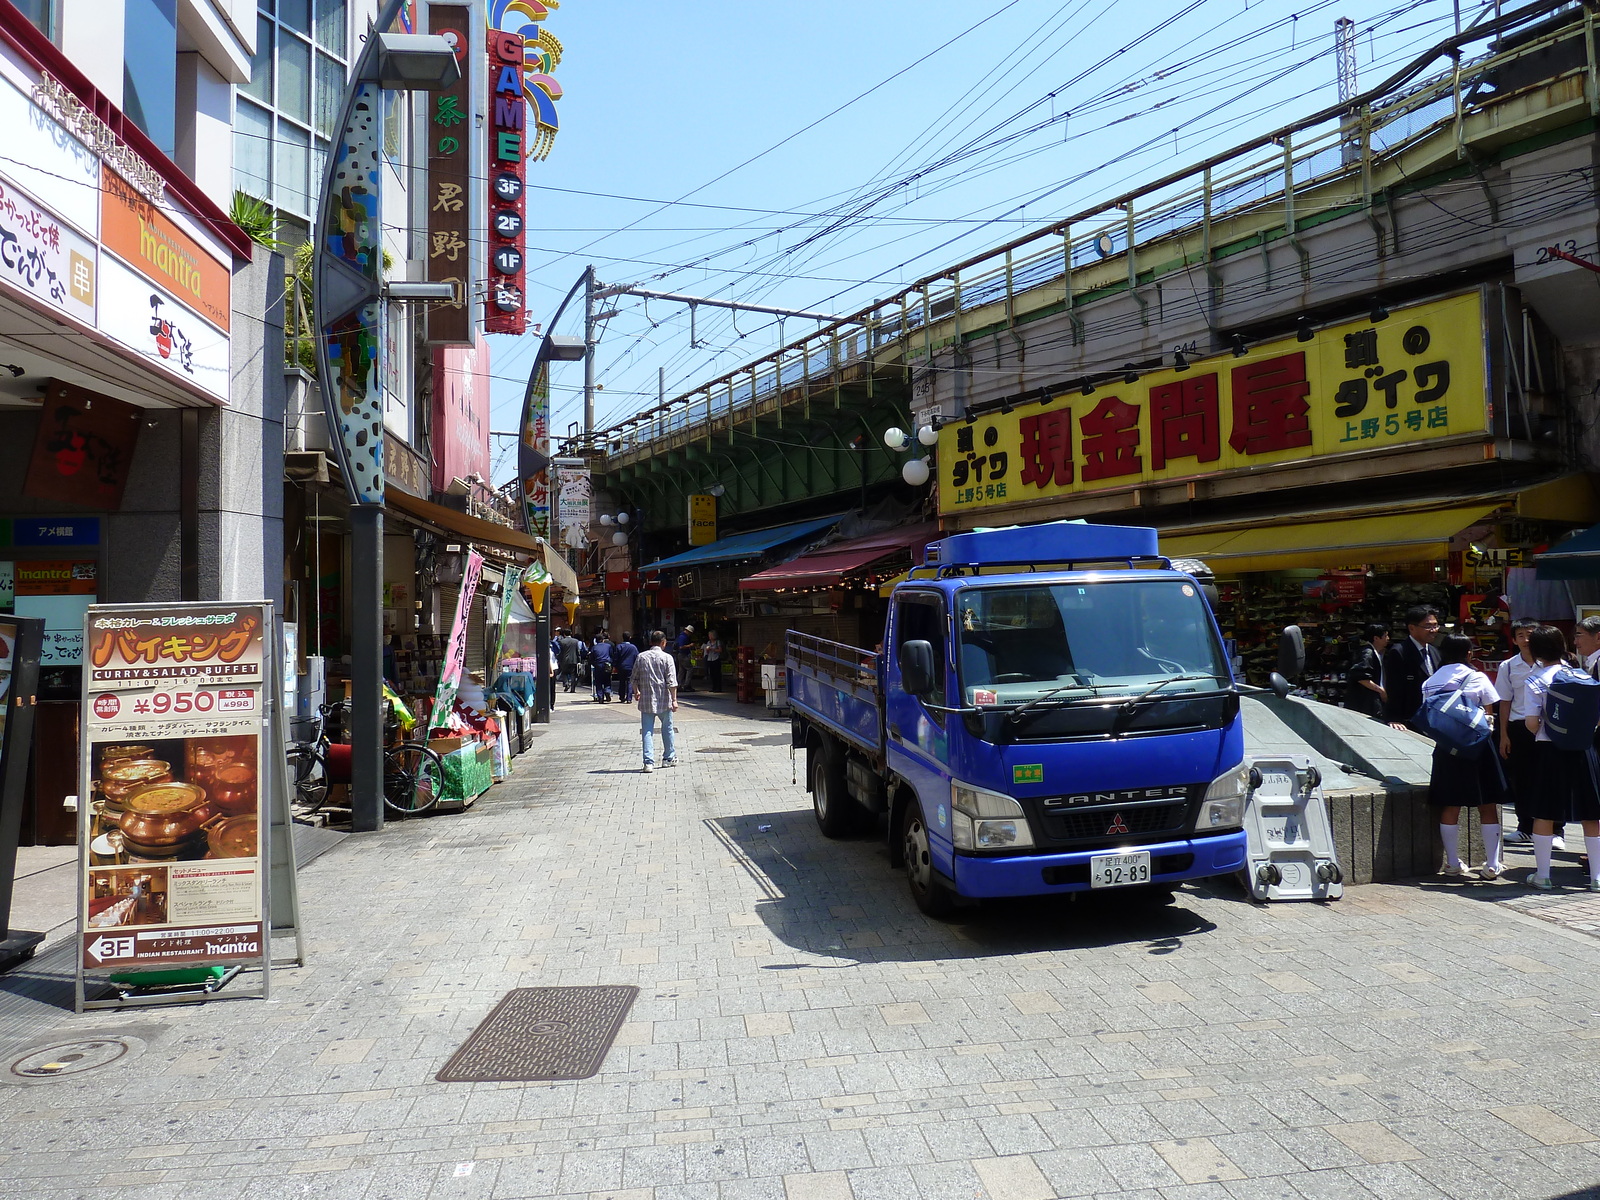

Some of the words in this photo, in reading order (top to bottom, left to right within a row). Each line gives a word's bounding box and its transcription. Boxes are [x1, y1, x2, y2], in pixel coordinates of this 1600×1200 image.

[496, 33, 523, 162] GAME
[498, 178, 520, 194] 3F
[498, 216, 520, 230] 2F
[138, 214, 201, 298] mantra
[498, 253, 519, 268] 1F
[74, 260, 90, 297] 串
[1335, 360, 1449, 418] ダイワ
[1019, 351, 1312, 489] 現金問屋
[1340, 406, 1448, 443] 上野5号店
[952, 452, 1008, 487] ダイワ
[954, 483, 1007, 504] 上野5号店
[38, 526, 74, 537] アメ横館
[692, 519, 715, 527] face
[1465, 548, 1521, 567] SALE
[18, 568, 72, 579] mantra
[92, 617, 257, 667] バイキング
[205, 664, 257, 675] BUFFET
[133, 691, 215, 714] ¥950
[1043, 786, 1188, 806] CANTER
[1105, 857, 1122, 866] 足立
[1122, 855, 1138, 864] 400
[1104, 864, 1147, 884] 92-89
[100, 940, 130, 957] 3F
[152, 939, 192, 947] インド料理
[161, 948, 205, 957] RESTAURANT
[205, 941, 258, 955] mantra
